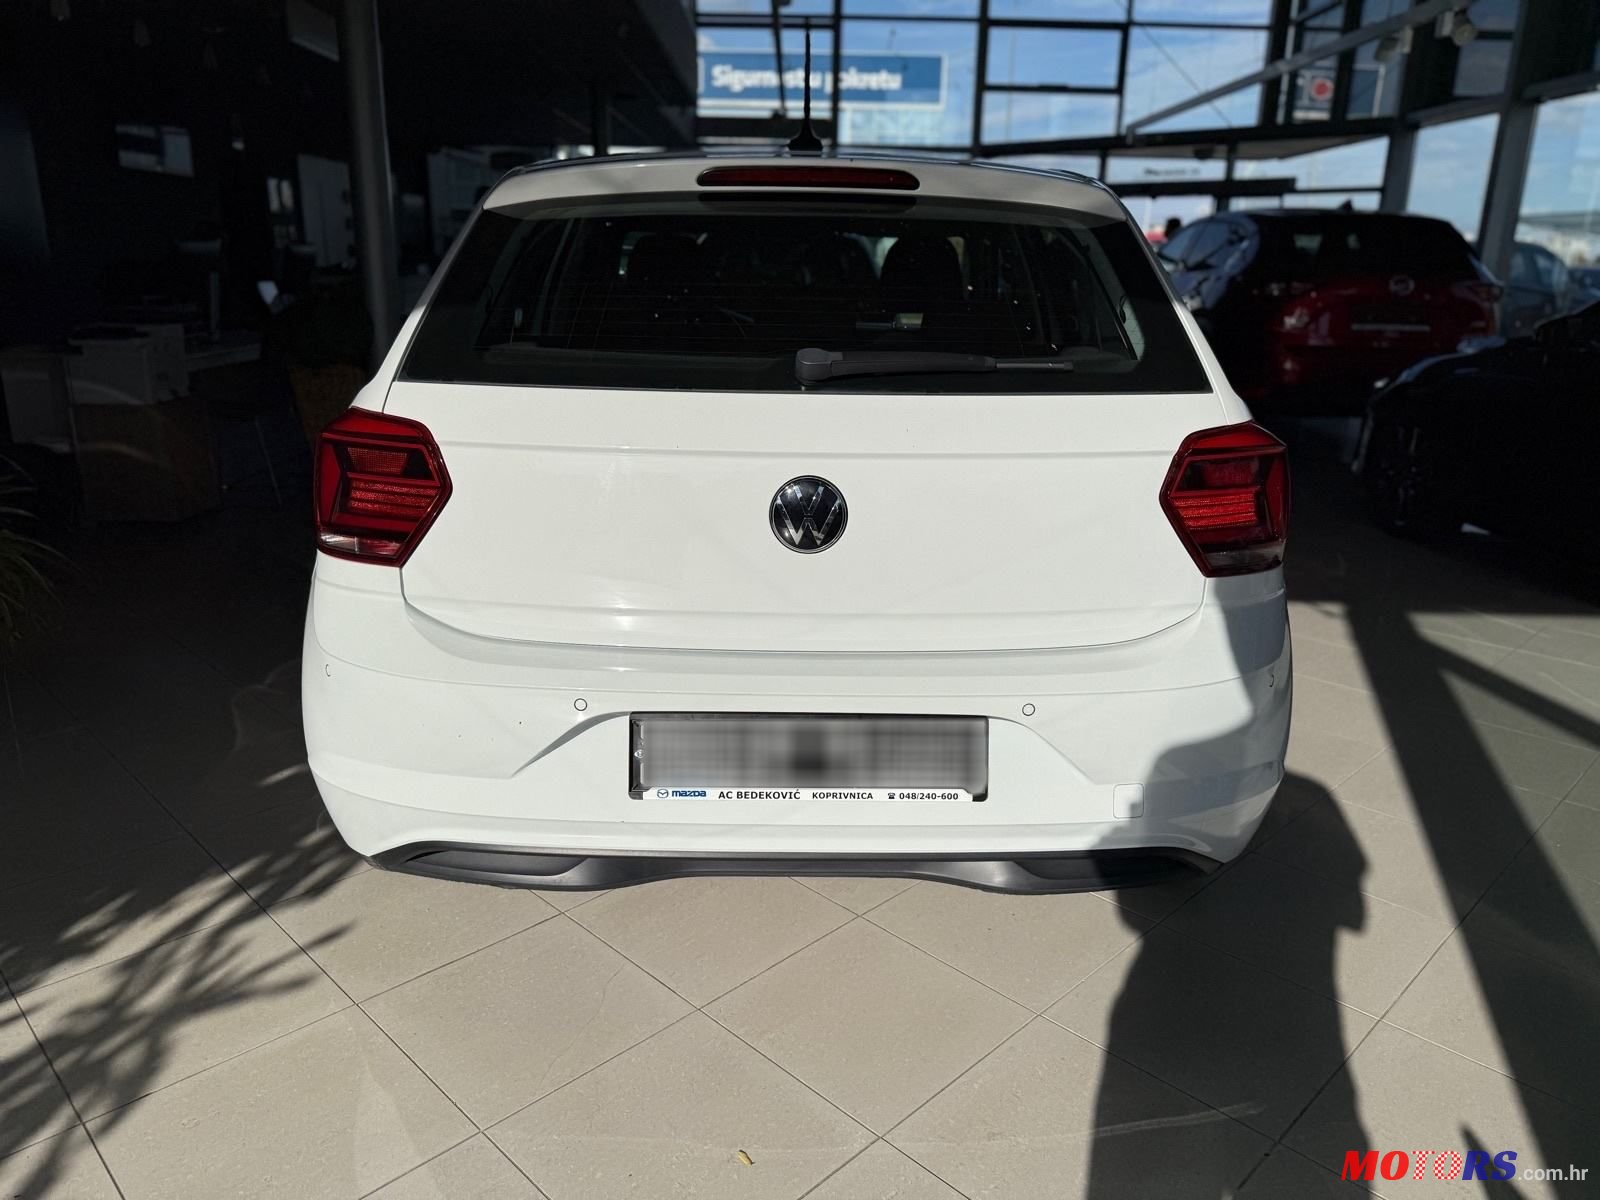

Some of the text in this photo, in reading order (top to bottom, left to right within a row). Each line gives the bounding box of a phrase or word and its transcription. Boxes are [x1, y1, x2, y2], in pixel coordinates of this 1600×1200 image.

[718, 791, 733, 800] AC
[736, 788, 801, 800] BEDEKOVIĆ
[812, 791, 874, 800] KOPRIVNICA
[899, 792, 959, 801] 048/240-600
